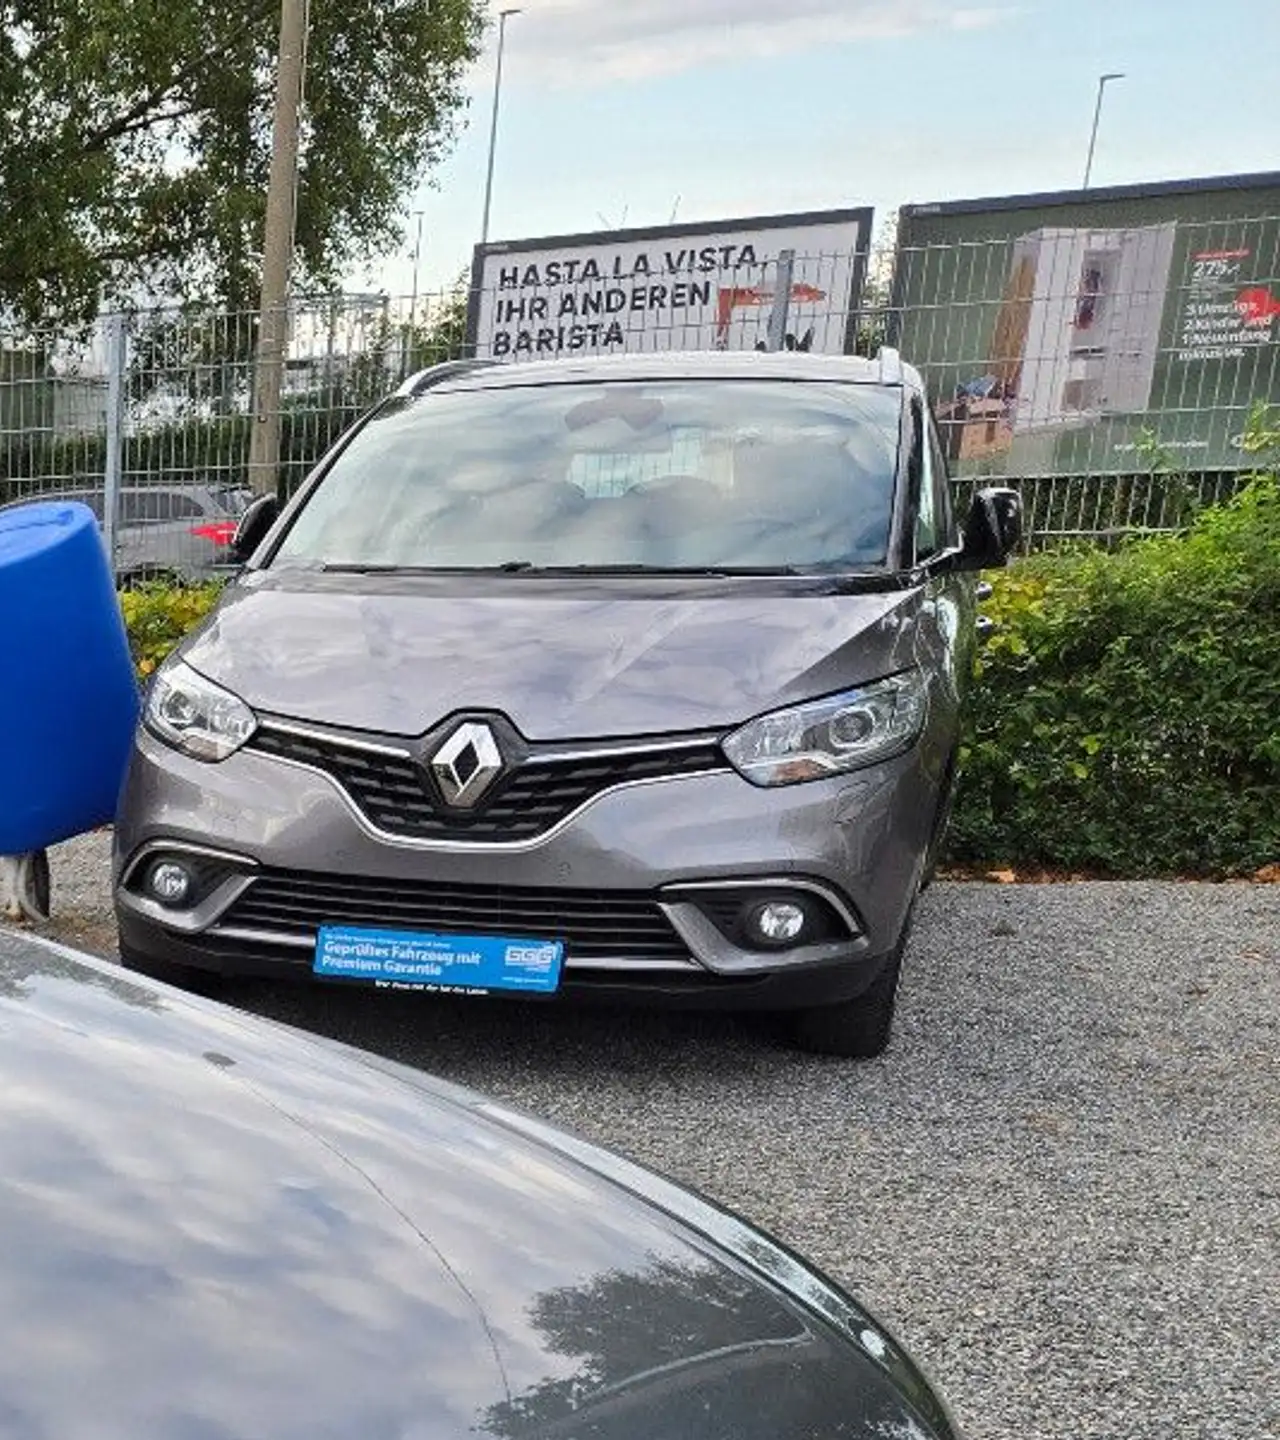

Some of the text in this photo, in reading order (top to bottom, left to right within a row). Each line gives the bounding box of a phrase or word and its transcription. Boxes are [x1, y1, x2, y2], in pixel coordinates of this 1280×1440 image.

[499, 258, 600, 291] HASTA
[613, 253, 651, 280] LA
[496, 280, 710, 324] IHR ANDEREN
[493, 322, 624, 357] BARISTA
[322, 955, 442, 976] Premium Garantie
[324, 941, 390, 958] Geprüftes
[392, 946, 455, 965] Fahrzeug
[456, 951, 481, 967] mit
